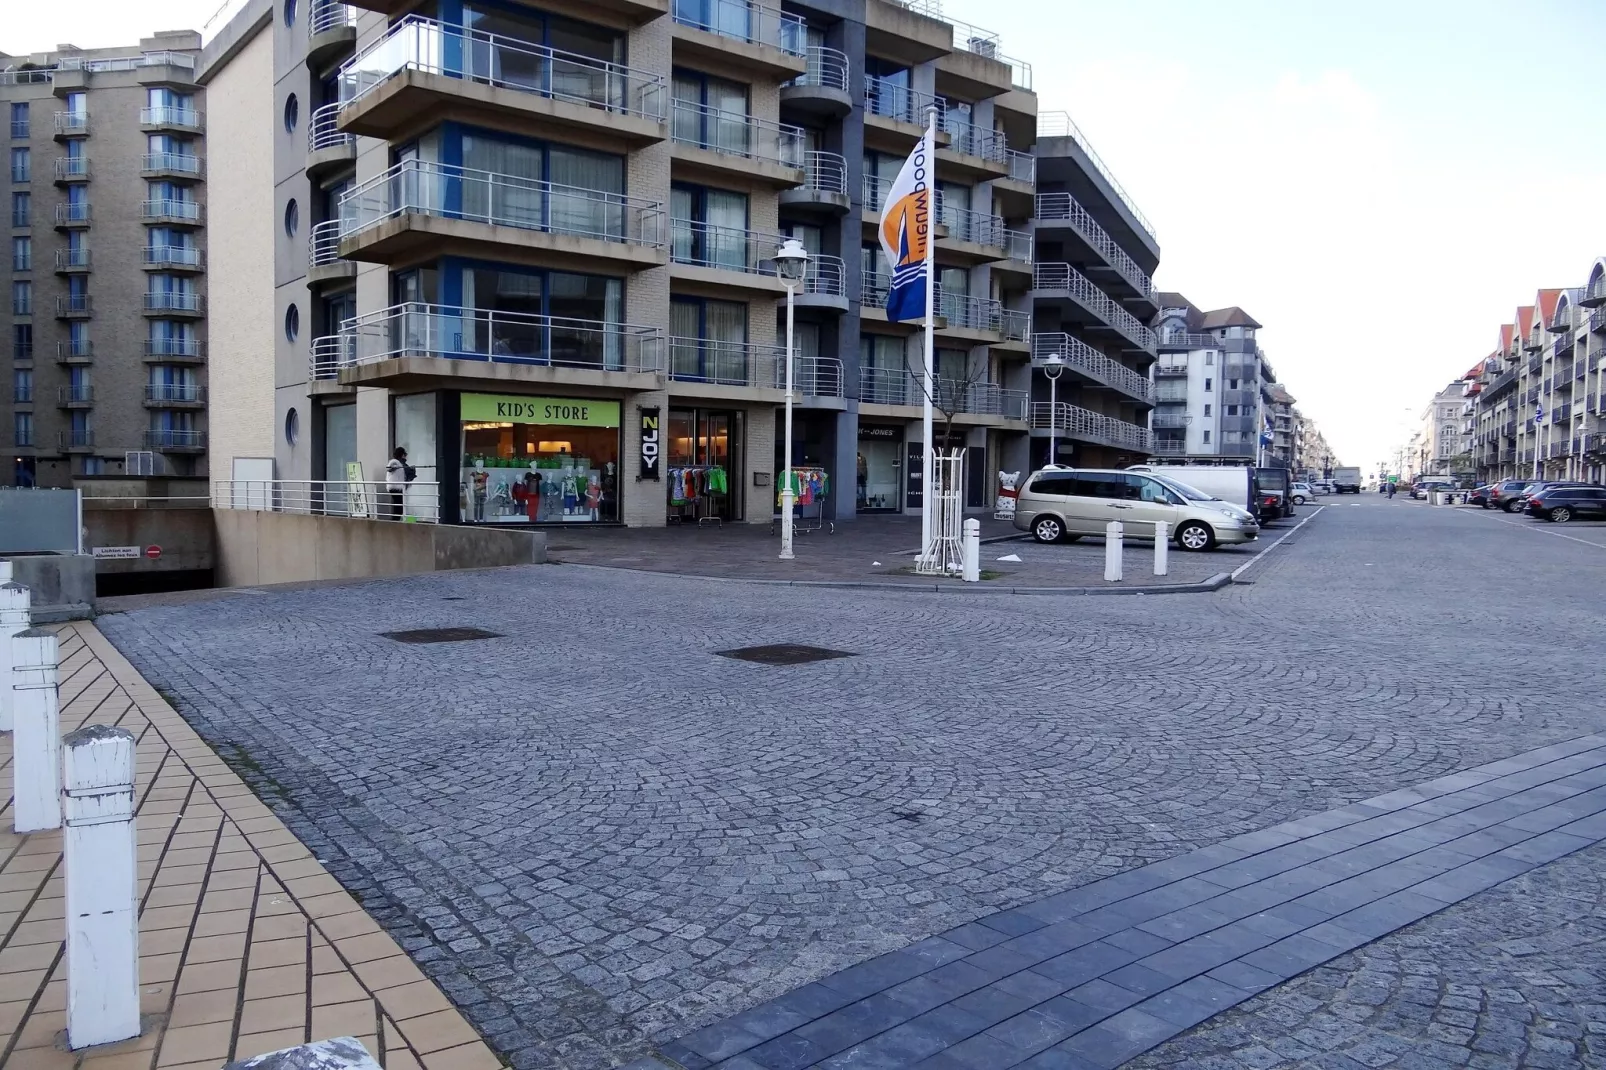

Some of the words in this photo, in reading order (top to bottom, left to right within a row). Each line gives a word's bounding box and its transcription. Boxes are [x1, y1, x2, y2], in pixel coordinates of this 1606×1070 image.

[497, 402, 535, 418] KID'S
[545, 405, 588, 420] STORE
[643, 416, 658, 468] NJOY
